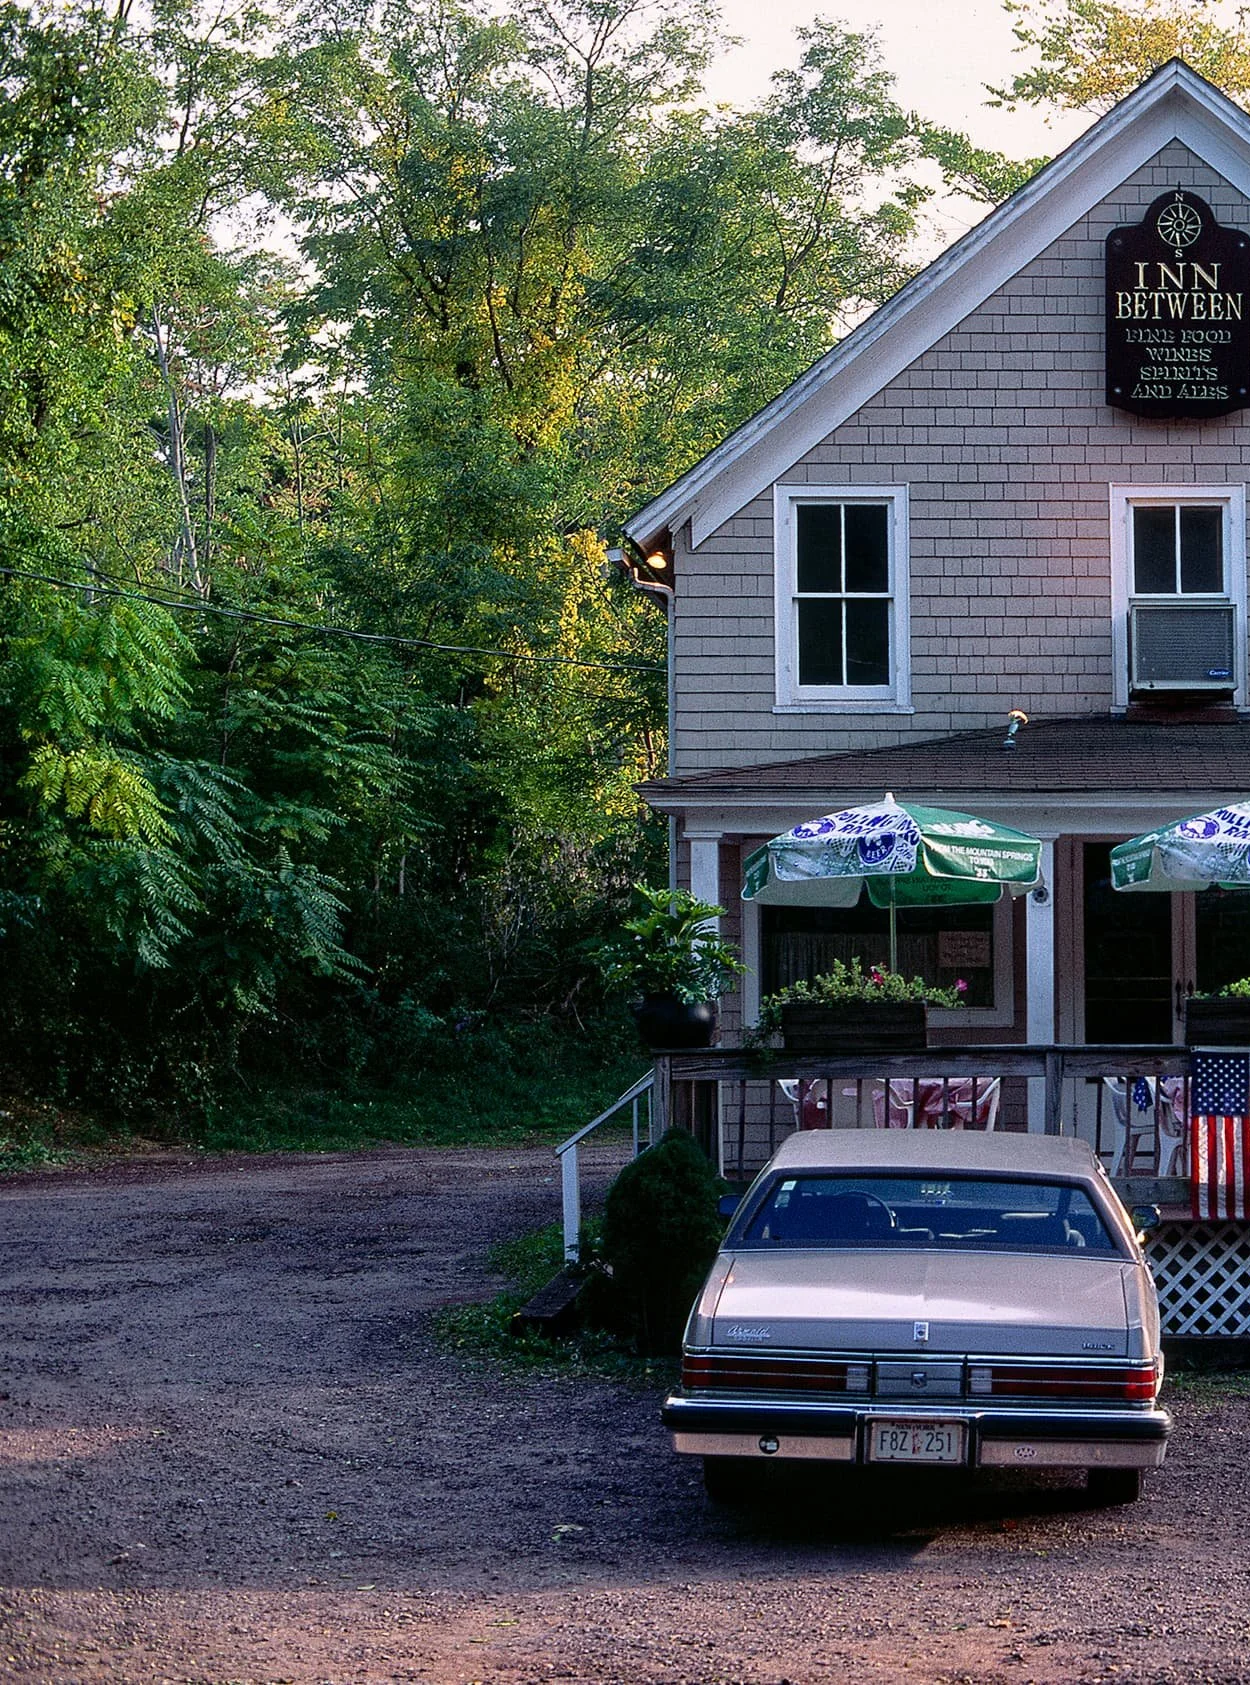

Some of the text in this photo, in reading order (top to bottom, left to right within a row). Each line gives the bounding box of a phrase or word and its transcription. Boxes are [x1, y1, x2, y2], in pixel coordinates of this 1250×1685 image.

[1175, 193, 1184, 202] N
[1175, 249, 1183, 258] S
[1134, 262, 1222, 290] INN
[1115, 291, 1244, 320] BETWEEN
[1126, 328, 1232, 343] FINE FOOD
[1146, 347, 1213, 362] WINES
[1140, 366, 1219, 380] SPIRITS
[1131, 384, 1229, 400] AND ALES
[866, 846, 887, 859] BEER
[952, 846, 965, 855] THE
[966, 847, 1001, 858] MOUNTAIN
[1002, 850, 1034, 862] SPRINGS
[970, 856, 978, 864] TO
[880, 1430, 952, 1453] F8Z 251
